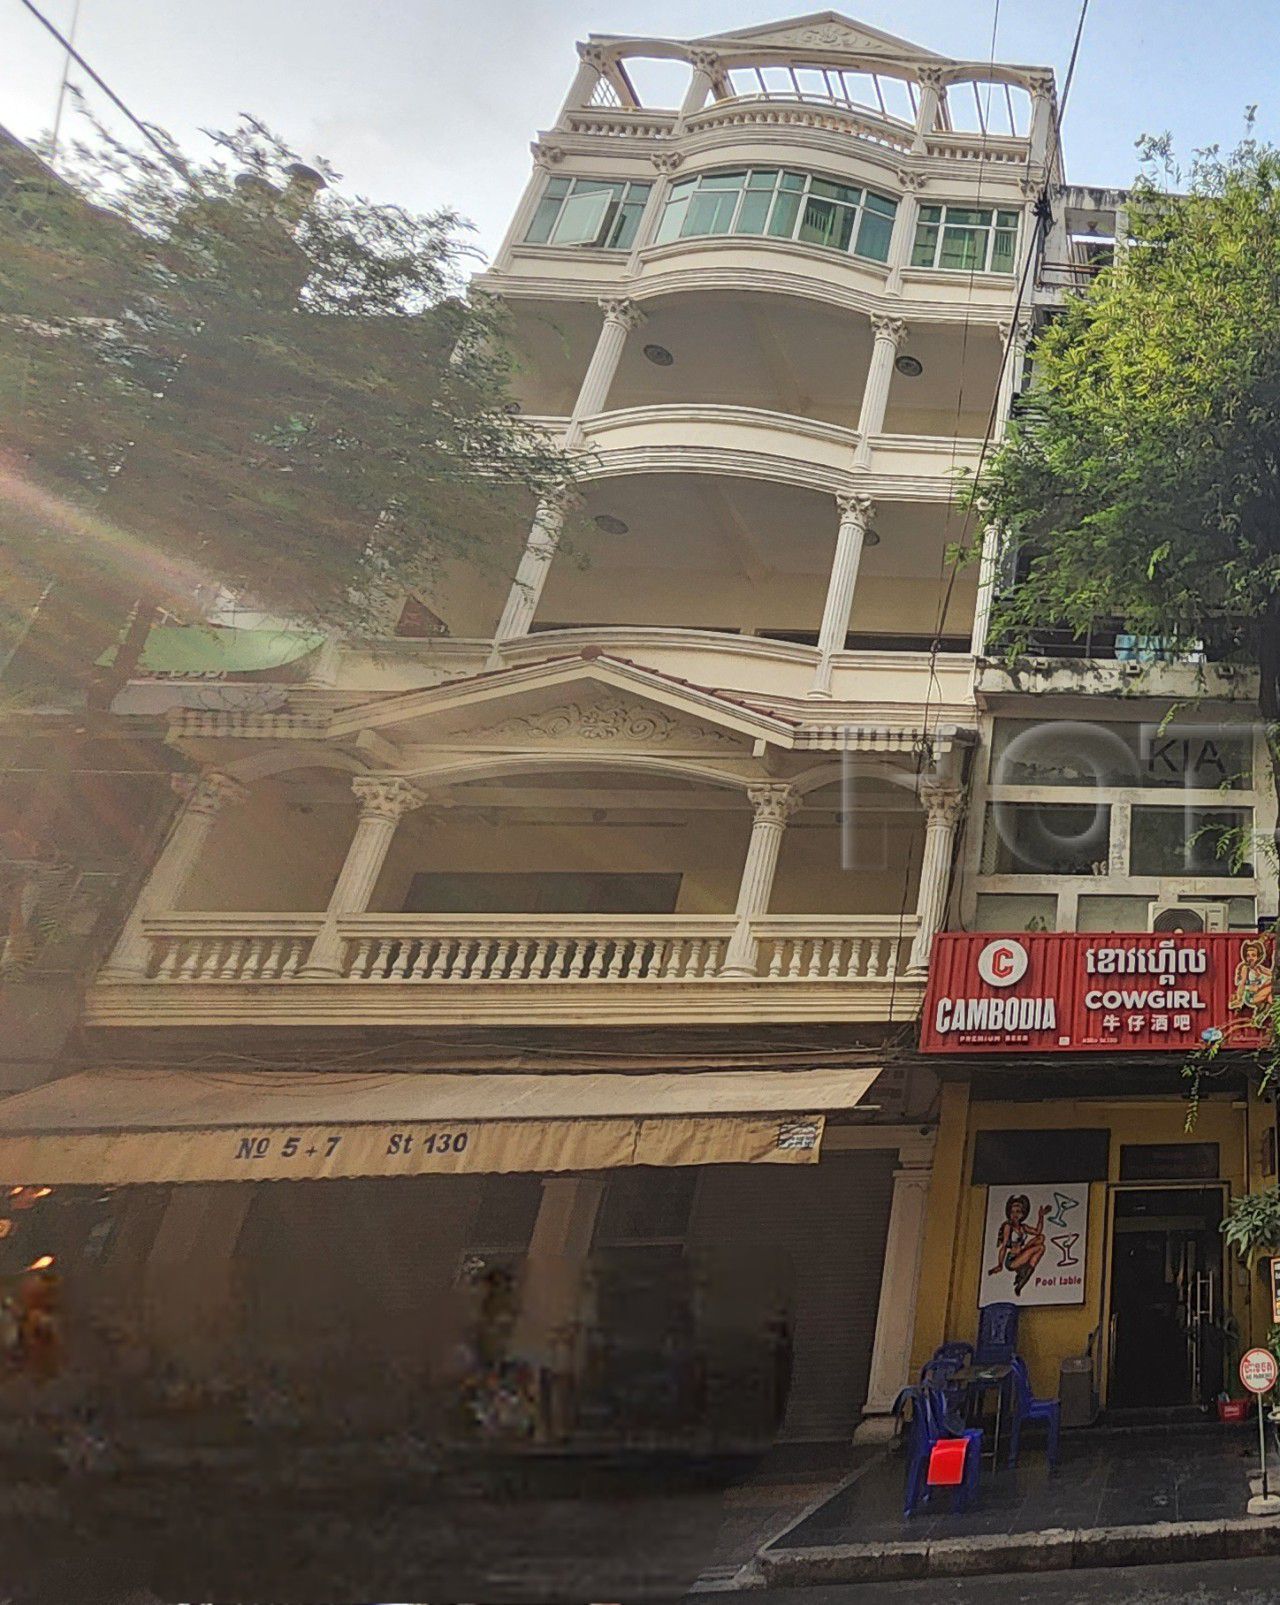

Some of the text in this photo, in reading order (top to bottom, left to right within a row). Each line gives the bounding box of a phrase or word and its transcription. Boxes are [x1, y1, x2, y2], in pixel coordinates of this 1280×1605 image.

[1149, 739, 1226, 773] KIA
[1085, 990, 1206, 1010] COWGIRL
[935, 997, 1056, 1033] CAMBODIA
[1103, 1014, 1191, 1031] 牛仔酒吧
[387, 1133, 413, 1155] St
[422, 1132, 469, 1154] 130
[1035, 1276, 1082, 1287] Pool table
